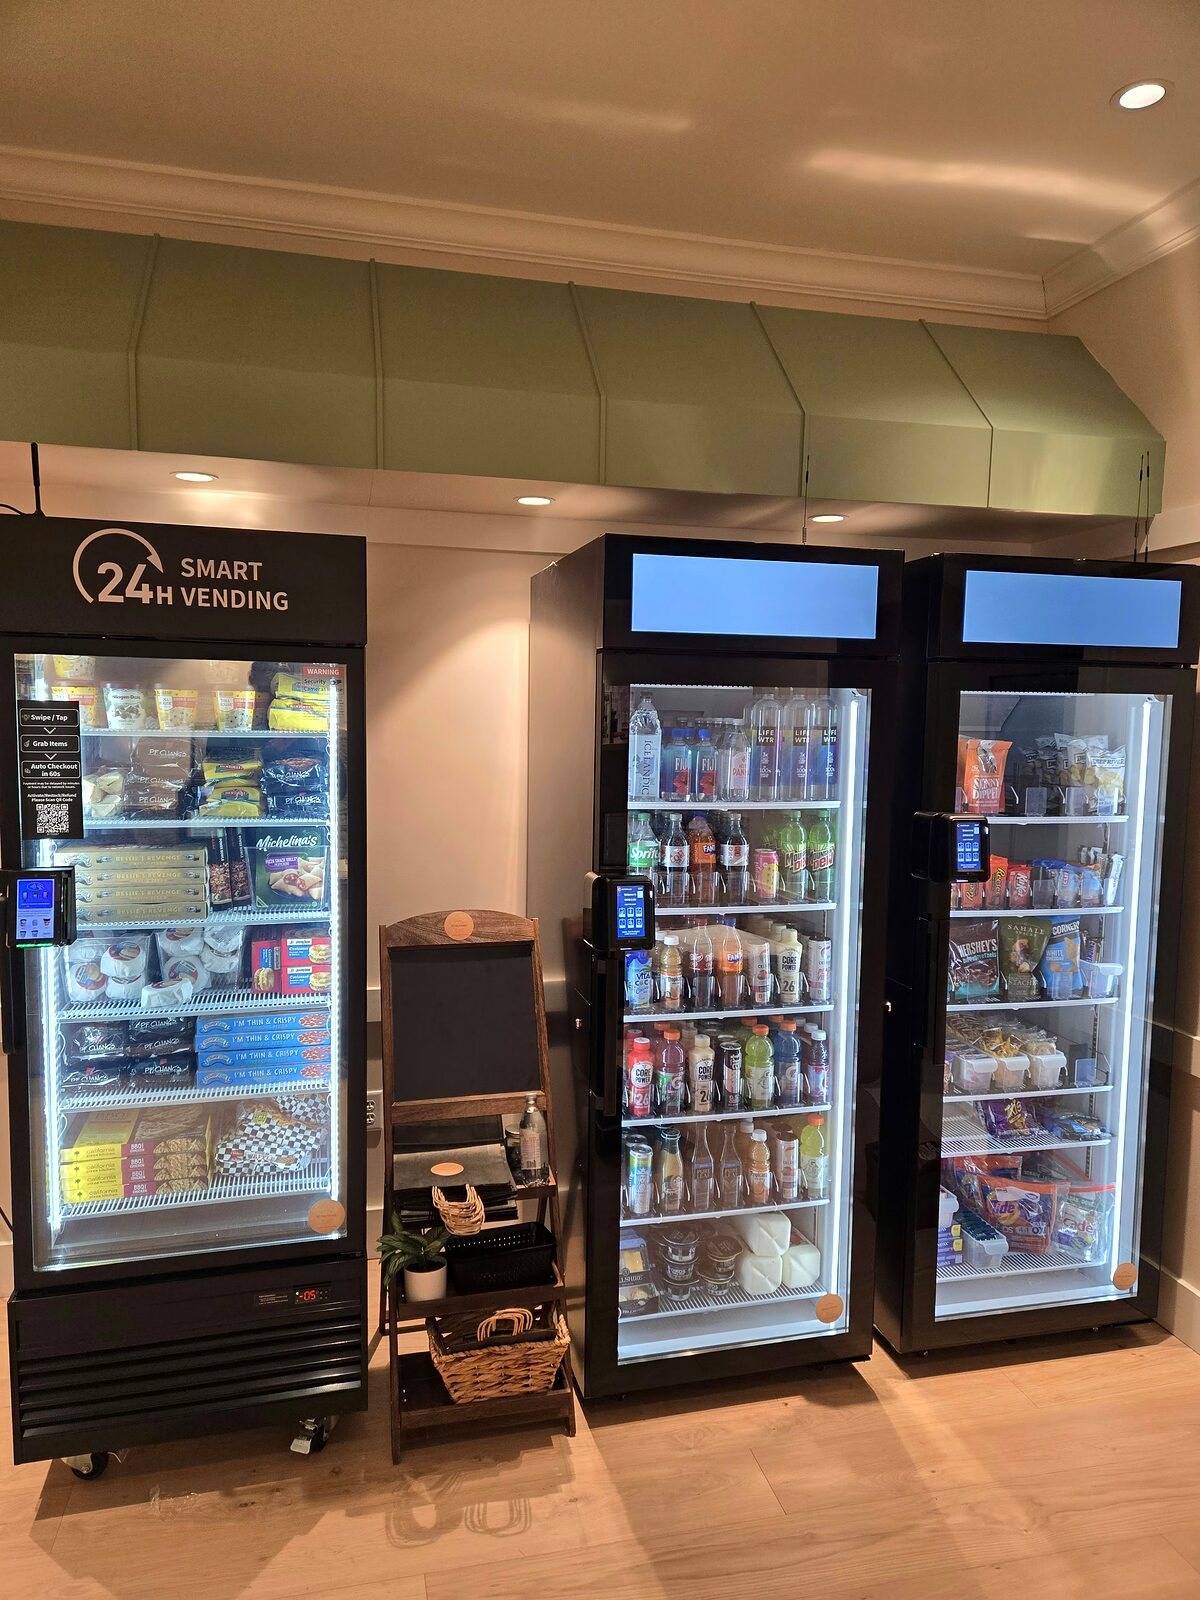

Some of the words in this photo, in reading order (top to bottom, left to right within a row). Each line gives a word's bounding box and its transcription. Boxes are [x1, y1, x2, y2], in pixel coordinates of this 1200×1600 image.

[180, 558, 262, 581] SMART
[180, 586, 288, 611] VENDING
[307, 668, 340, 676] WARNING
[31, 714, 50, 722] Swipe
[56, 714, 68, 722] Tap
[642, 740, 652, 795] ICELANDIC
[256, 835, 317, 852] Michelina's
[958, 939, 998, 958] HERSHEY'S
[782, 956, 797, 964] CORE
[784, 980, 794, 992] 26
[273, 1016, 297, 1024] CRISPY
[275, 1049, 299, 1057] CRISPY
[274, 1067, 298, 1075] CRISPY
[636, 1068, 651, 1076] CORE
[699, 1066, 712, 1075] CORE
